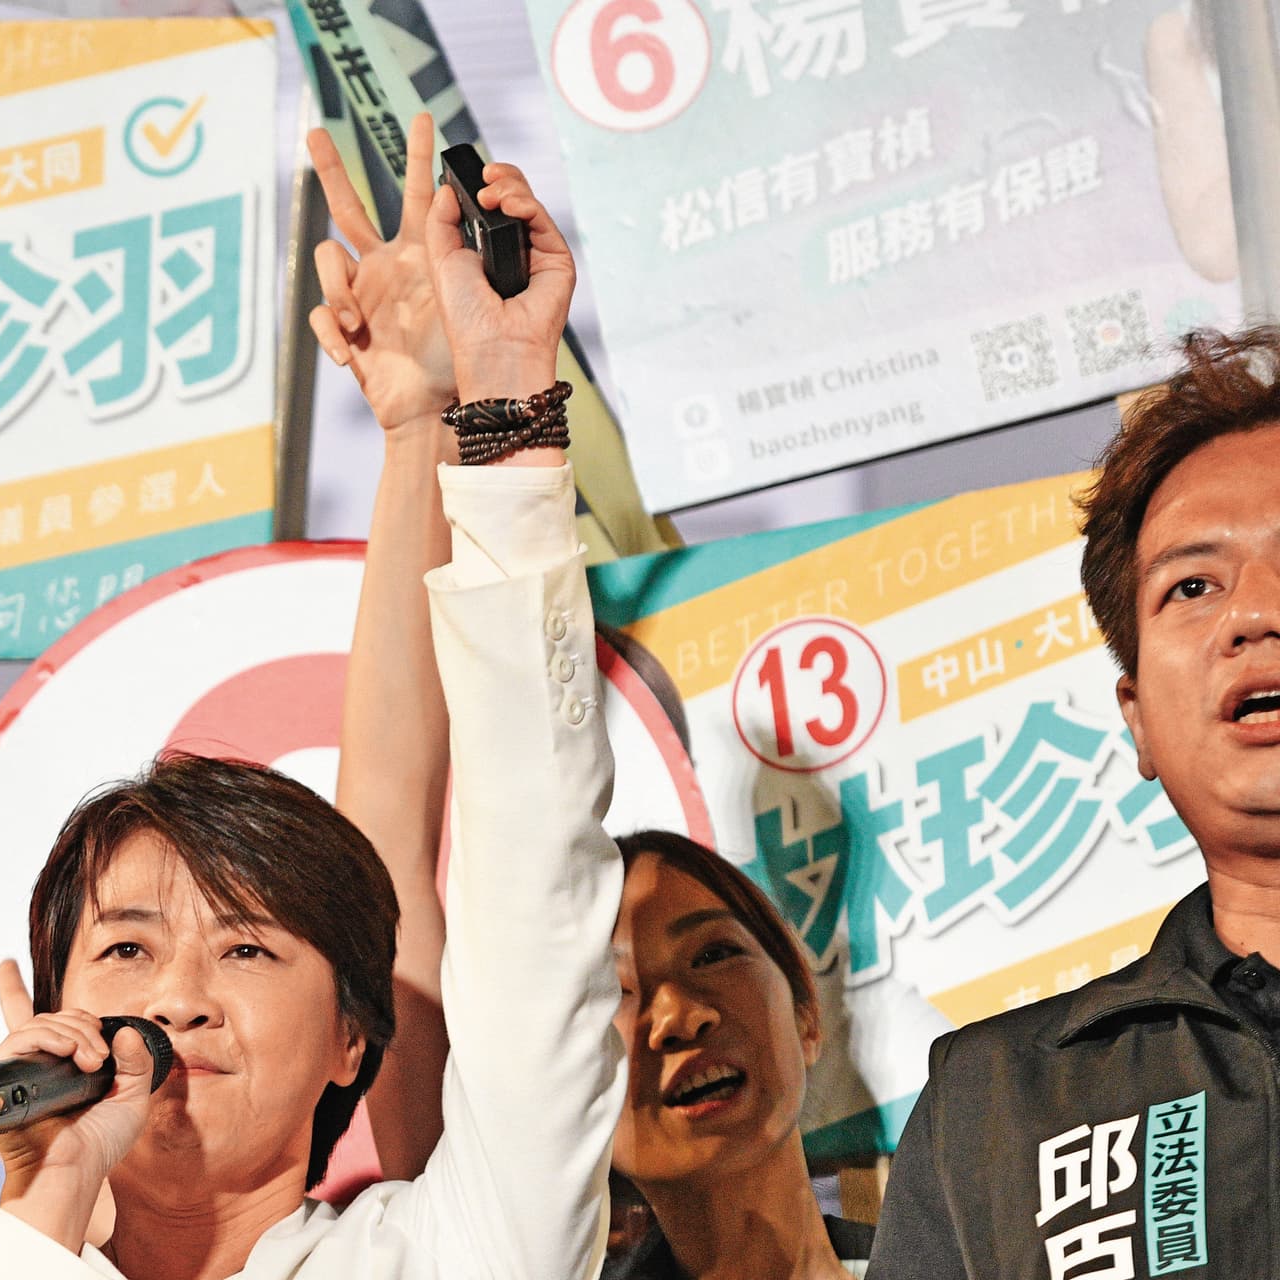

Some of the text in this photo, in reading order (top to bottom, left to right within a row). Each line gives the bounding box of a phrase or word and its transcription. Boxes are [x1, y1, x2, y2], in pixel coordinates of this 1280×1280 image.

[589, 0, 677, 112] 6
[658, 106, 935, 253] 松信有寶楨
[826, 133, 1104, 286] 服務有保證
[748, 398, 926, 461] baozhenyang
[820, 345, 941, 400] Christina
[677, 579, 849, 681] BETTER
[757, 634, 860, 758] 13
[1151, 1102, 1201, 1271] 立法委員
